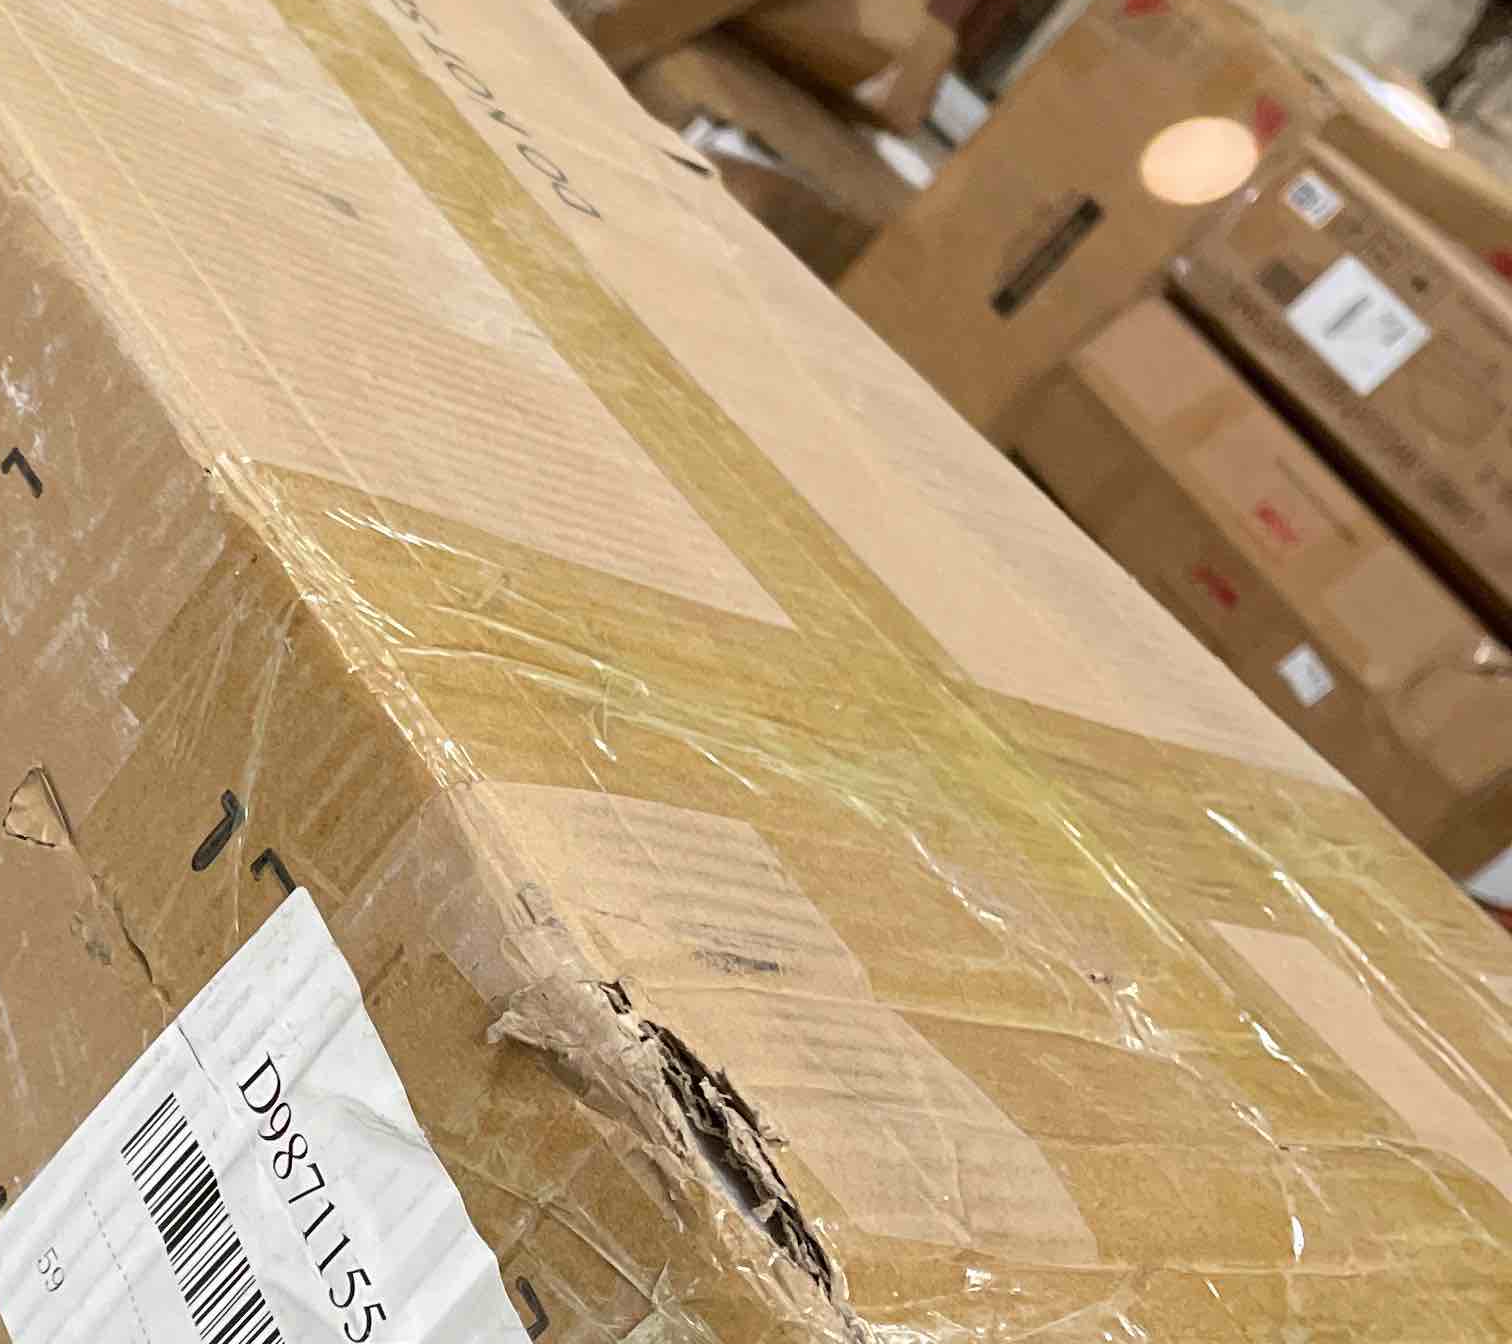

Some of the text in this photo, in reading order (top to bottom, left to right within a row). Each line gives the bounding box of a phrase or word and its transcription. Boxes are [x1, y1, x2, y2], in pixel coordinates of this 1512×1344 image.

[419, 30, 532, 139] NOT
[516, 142, 602, 218] DO
[37, 1246, 66, 1293] 59
